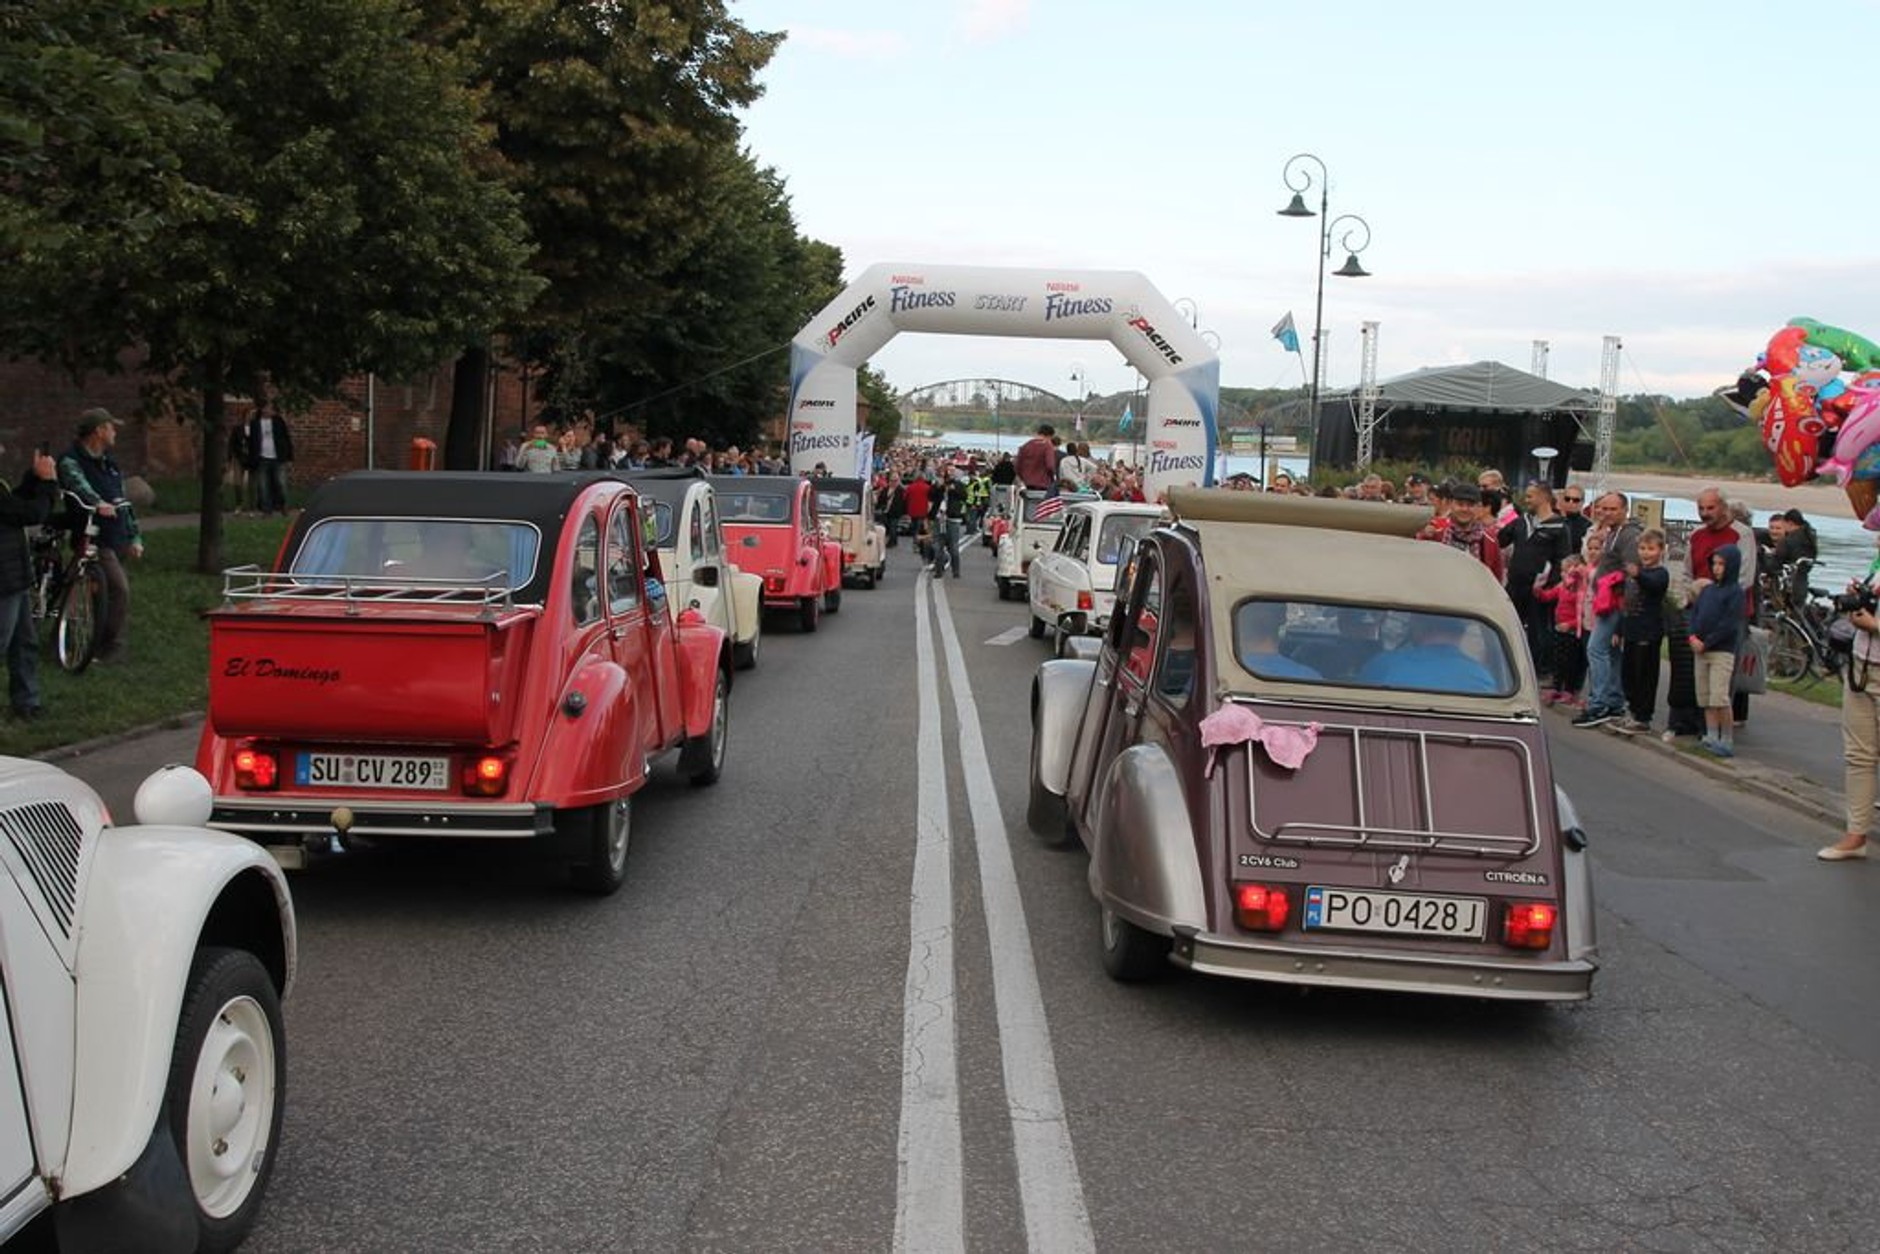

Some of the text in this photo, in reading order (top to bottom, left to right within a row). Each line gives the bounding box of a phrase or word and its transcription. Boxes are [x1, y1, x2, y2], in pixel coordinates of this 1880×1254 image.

[891, 285, 956, 314] Fitness
[974, 294, 1028, 312] START
[1045, 293, 1113, 322] Fitness
[827, 294, 876, 348] PACIFIC
[1127, 315, 1183, 365] PACIFIC
[791, 431, 841, 457] Fitness
[1151, 450, 1204, 474] Fitness
[223, 658, 341, 687] El Domingo
[311, 756, 340, 782] SU
[356, 758, 385, 784] CV
[390, 760, 432, 785] 289
[1240, 855, 1298, 868] 2CV6 Club
[1326, 893, 1373, 926] PO
